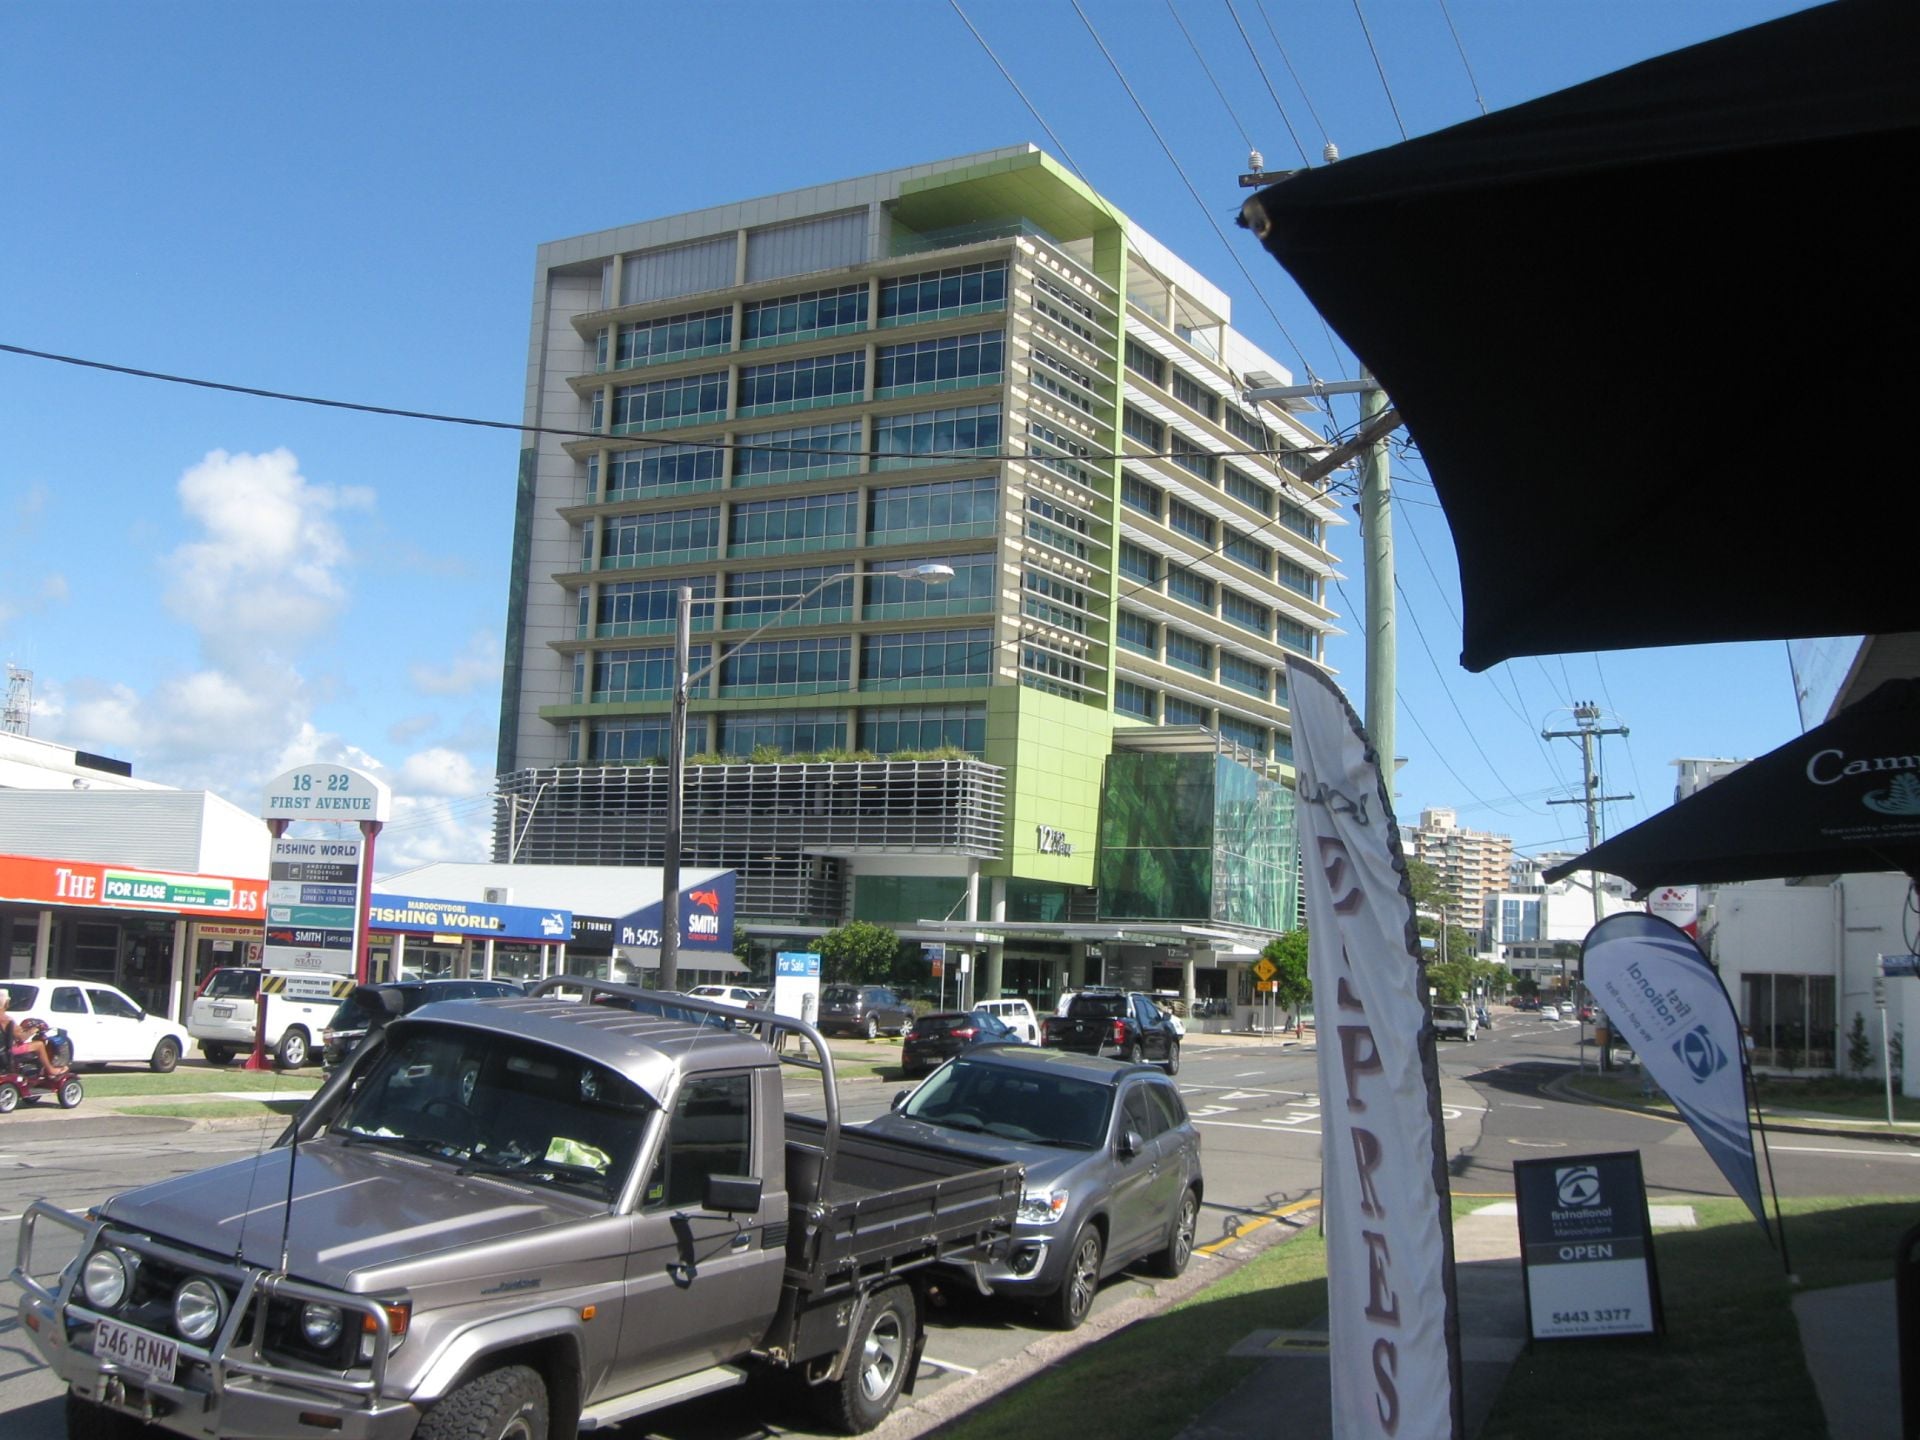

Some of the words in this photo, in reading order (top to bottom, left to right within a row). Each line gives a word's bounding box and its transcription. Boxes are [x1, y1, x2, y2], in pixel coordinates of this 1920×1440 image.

[1806, 749, 1920, 785] Cam
[292, 774, 311, 791] 18
[327, 774, 349, 791] 22
[270, 796, 311, 809] FIRST
[315, 797, 371, 810] AVENUE
[276, 844, 315, 855] FISHING
[320, 845, 357, 856] WORLD
[56, 868, 96, 898] THE
[107, 881, 132, 896] FOR
[133, 884, 166, 899] LEASE
[408, 901, 466, 913] MAROOCHYDORE
[369, 907, 437, 926] FISHING
[442, 913, 499, 930] WORLD
[587, 922, 612, 932] TURNER
[688, 914, 718, 934] SMITH
[295, 931, 322, 942] SMITH
[622, 927, 635, 944] Ph
[636, 928, 659, 946] 5475
[779, 958, 792, 971] For
[794, 959, 806, 971] Sale
[1559, 1243, 1613, 1261] OPEN
[1552, 1311, 1589, 1324] 5443
[1595, 1309, 1631, 1323] 3377
